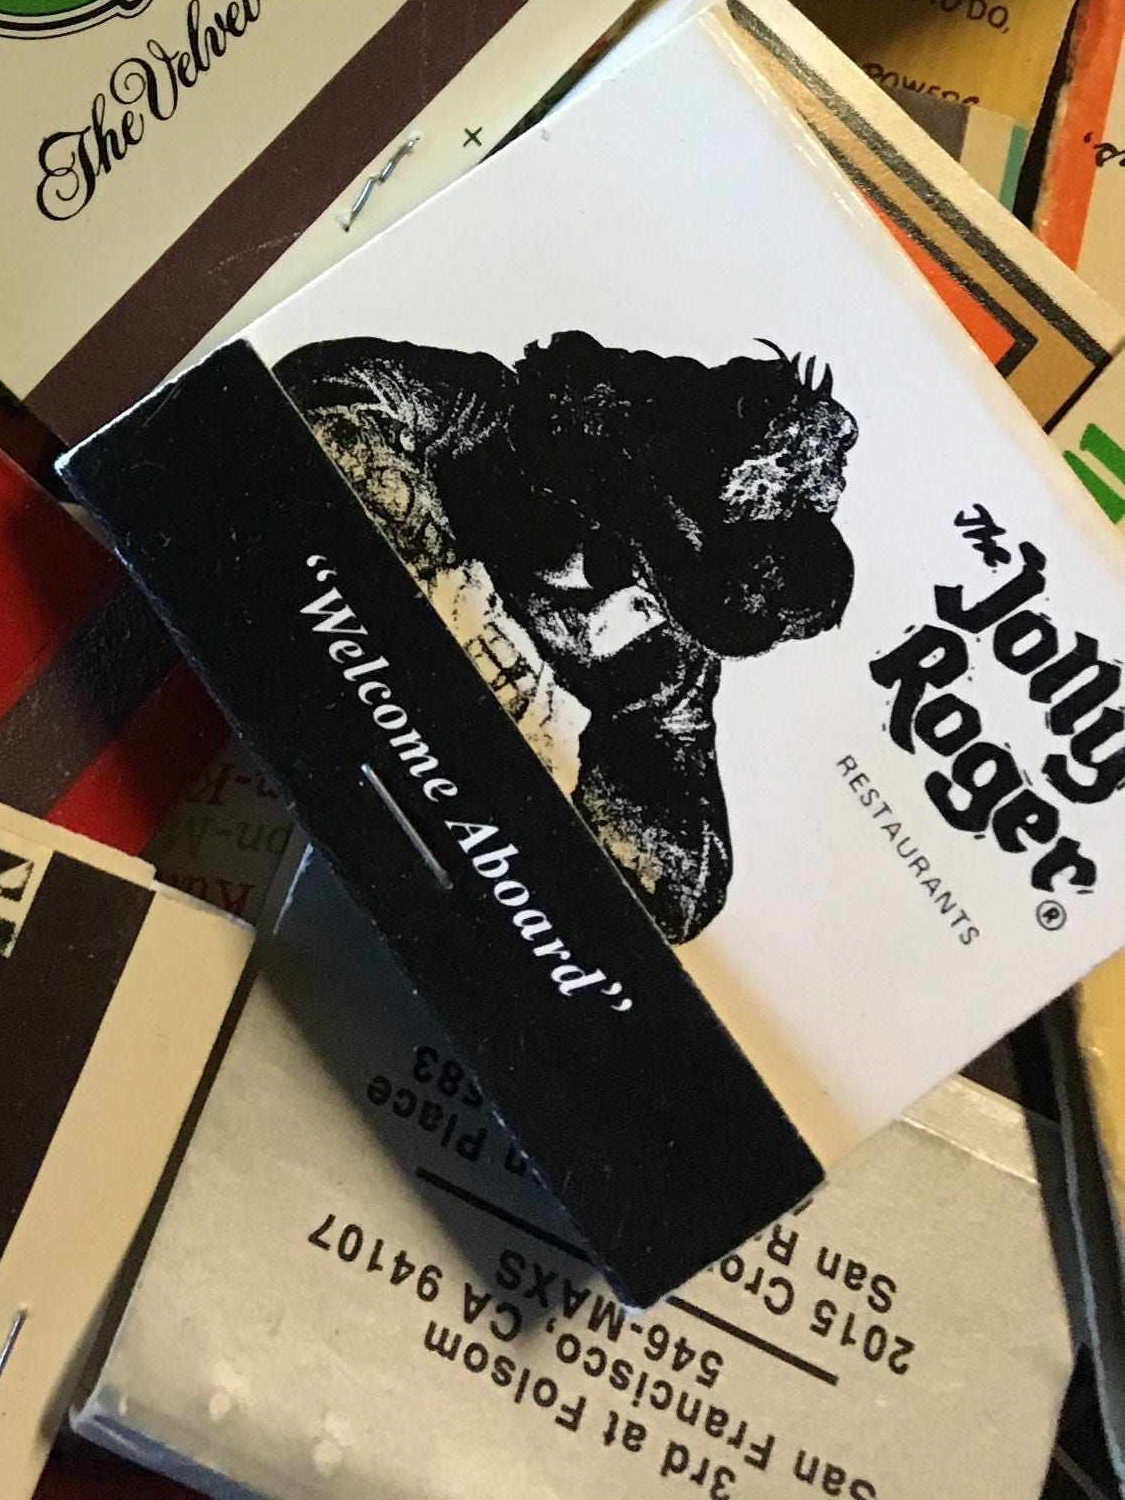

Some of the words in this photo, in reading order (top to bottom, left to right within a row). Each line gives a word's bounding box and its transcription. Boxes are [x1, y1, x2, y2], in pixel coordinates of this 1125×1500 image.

[36, 92, 145, 221] The
[953, 502, 1013, 568] The
[933, 540, 1125, 805] Jolly
[869, 623, 1097, 894] Roger
[835, 753, 981, 947] RESTAURANTS
[365, 1073, 489, 1164] Place
[307, 1212, 444, 1303] 94107
[713, 1252, 796, 1316] Cro
[815, 1246, 897, 1314] San
[463, 1280, 524, 1343] CA
[494, 1248, 725, 1390] 546-MAXS
[809, 1298, 917, 1377] 2015
[422, 1319, 588, 1434] Folsom
[546, 1317, 776, 1473] Francisco,
[602, 1409, 647, 1453] at
[659, 1438, 736, 1500] 3rd
